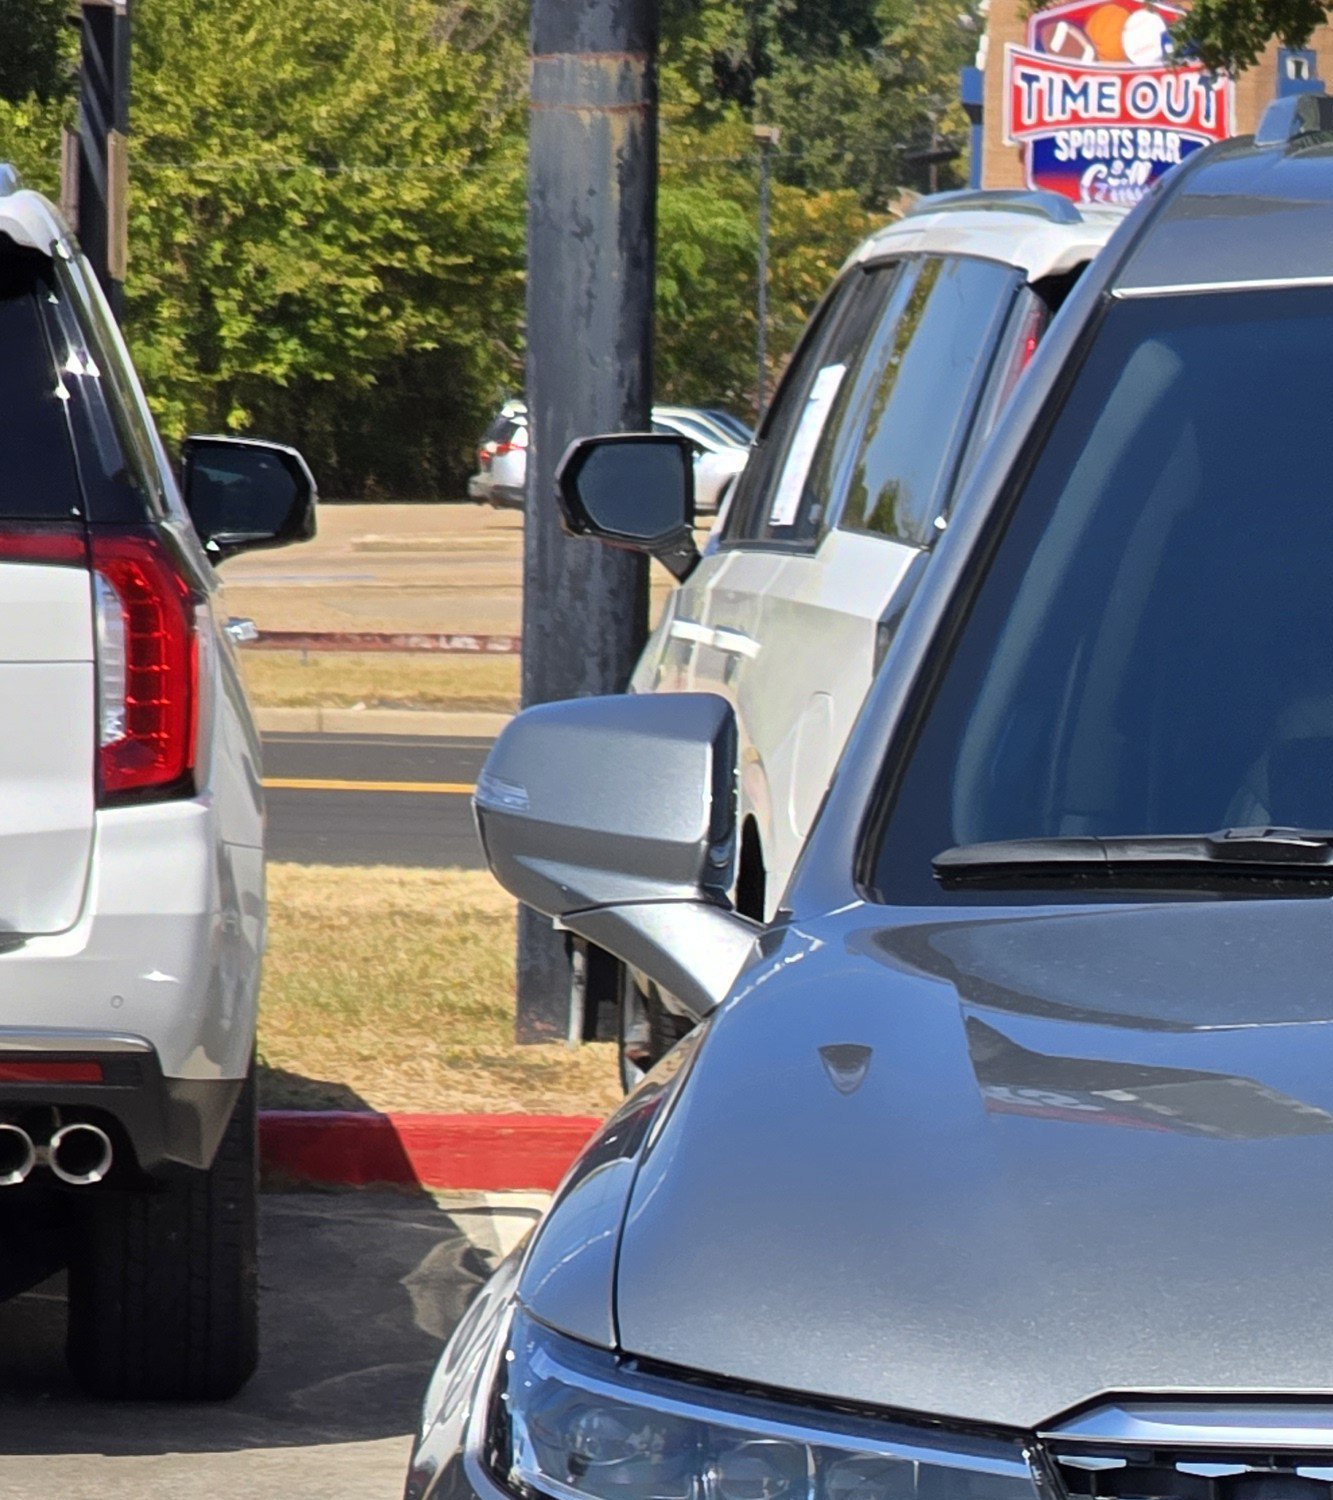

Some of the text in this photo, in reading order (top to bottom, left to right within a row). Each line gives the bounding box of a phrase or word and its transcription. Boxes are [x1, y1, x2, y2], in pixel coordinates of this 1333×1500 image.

[1019, 72, 1217, 123] TIME OUT
[1054, 129, 1182, 164] SPORTS BAR
